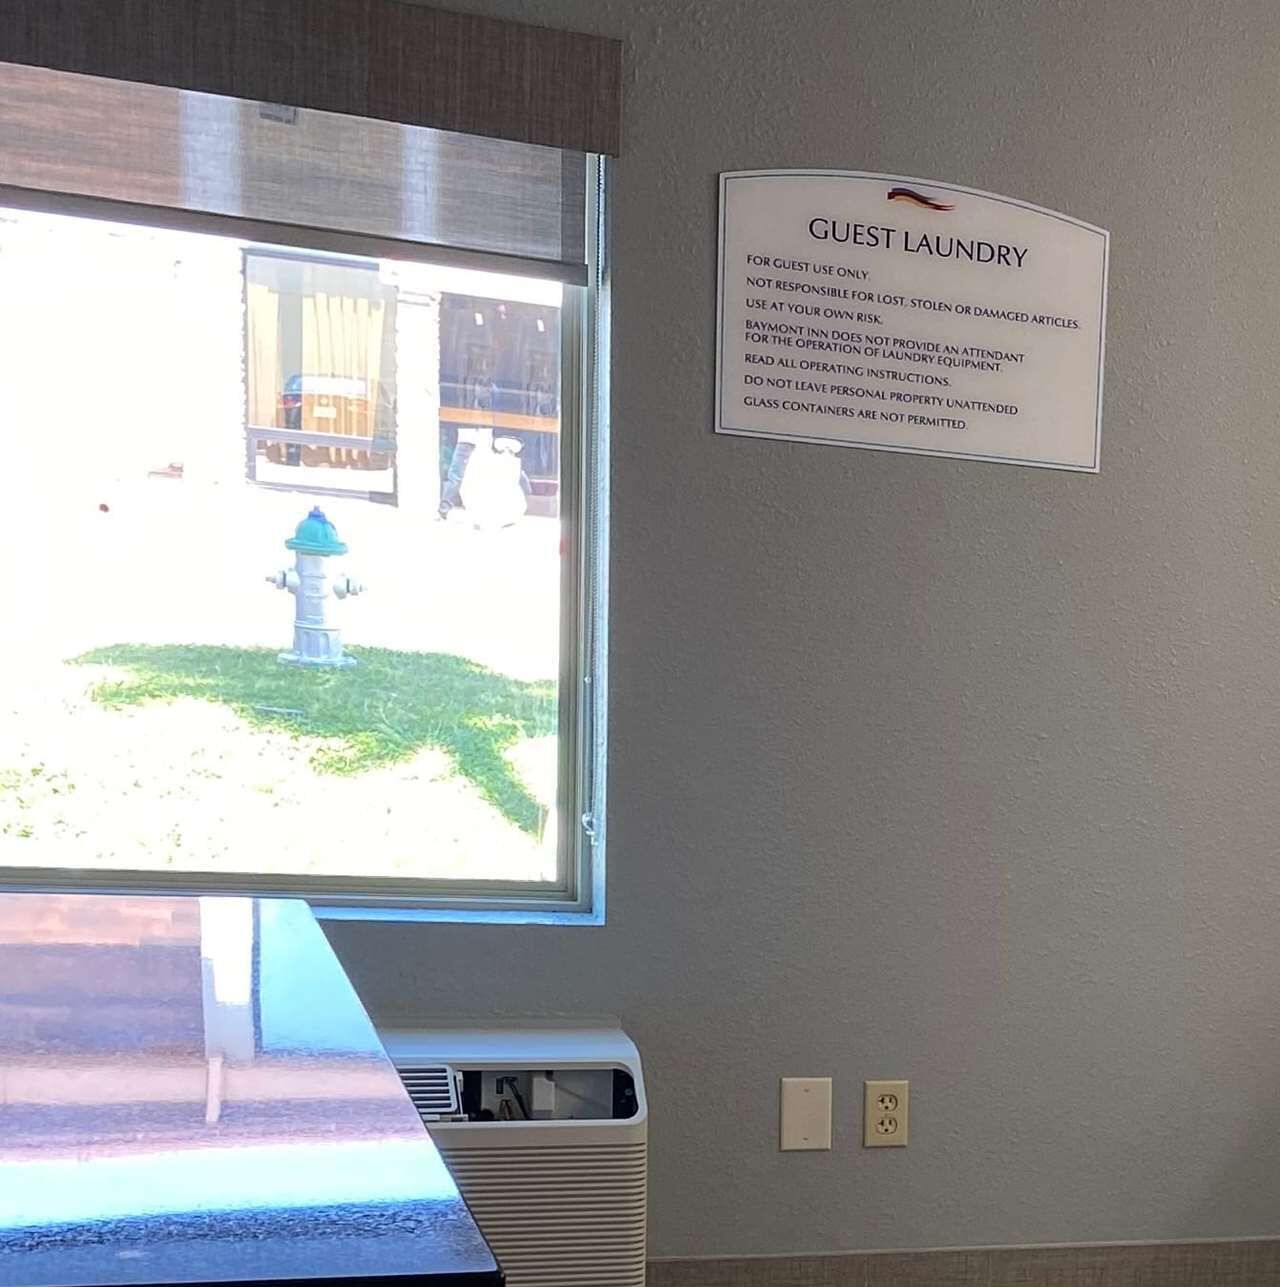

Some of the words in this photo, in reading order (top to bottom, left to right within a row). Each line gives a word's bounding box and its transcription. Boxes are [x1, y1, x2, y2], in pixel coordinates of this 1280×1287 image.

[809, 218, 896, 249] GUEST
[904, 231, 1028, 268] LAUNDRY
[747, 254, 770, 267] FOR
[773, 257, 810, 273] GUEST
[813, 264, 834, 276] USE
[837, 267, 871, 281] ONLY.
[746, 299, 767, 310] USE
[770, 302, 785, 312] AT
[788, 304, 820, 316] YOUR
[823, 308, 853, 320] OWN
[856, 312, 884, 325] RISK.
[747, 277, 772, 289] NOT
[775, 280, 849, 299] RESPONSIBLE
[852, 290, 874, 302] FOR
[911, 298, 952, 313] STOLEN
[955, 304, 972, 315] OR
[974, 306, 1029, 323] DAMAGED
[1030, 315, 1081, 330] ARTICLES.
[745, 332, 768, 344] FOR
[771, 335, 793, 346] THE
[796, 338, 861, 355] OPERATION
[864, 347, 879, 357] OF
[882, 350, 935, 365] LAUNDRY
[937, 355, 1004, 372] EQUIPMENT.
[746, 319, 804, 336] BAYMONT
[807, 327, 829, 339] INN
[831, 330, 862, 343] DOES
[865, 335, 890, 346] NOT
[893, 338, 941, 353] PROVIDE
[943, 345, 959, 356] AN
[962, 347, 1025, 363] ATTENDANT
[745, 353, 775, 366] READ
[777, 357, 797, 369] ALL
[799, 360, 864, 377] OPERATING
[867, 368, 952, 387] INSTRUCTIONS.
[744, 375, 764, 386] DO
[767, 378, 793, 389] NOT
[795, 381, 828, 394] LEAVE
[830, 385, 887, 401] PERSONAL
[890, 392, 944, 407] PROPERTY
[946, 398, 1018, 416] UNATTENDED
[744, 396, 780, 409] GLASS
[782, 400, 855, 418] CONTAINERS
[857, 409, 878, 420] ARE
[880, 412, 904, 423] NOT
[907, 414, 969, 430] PERMITTED.
